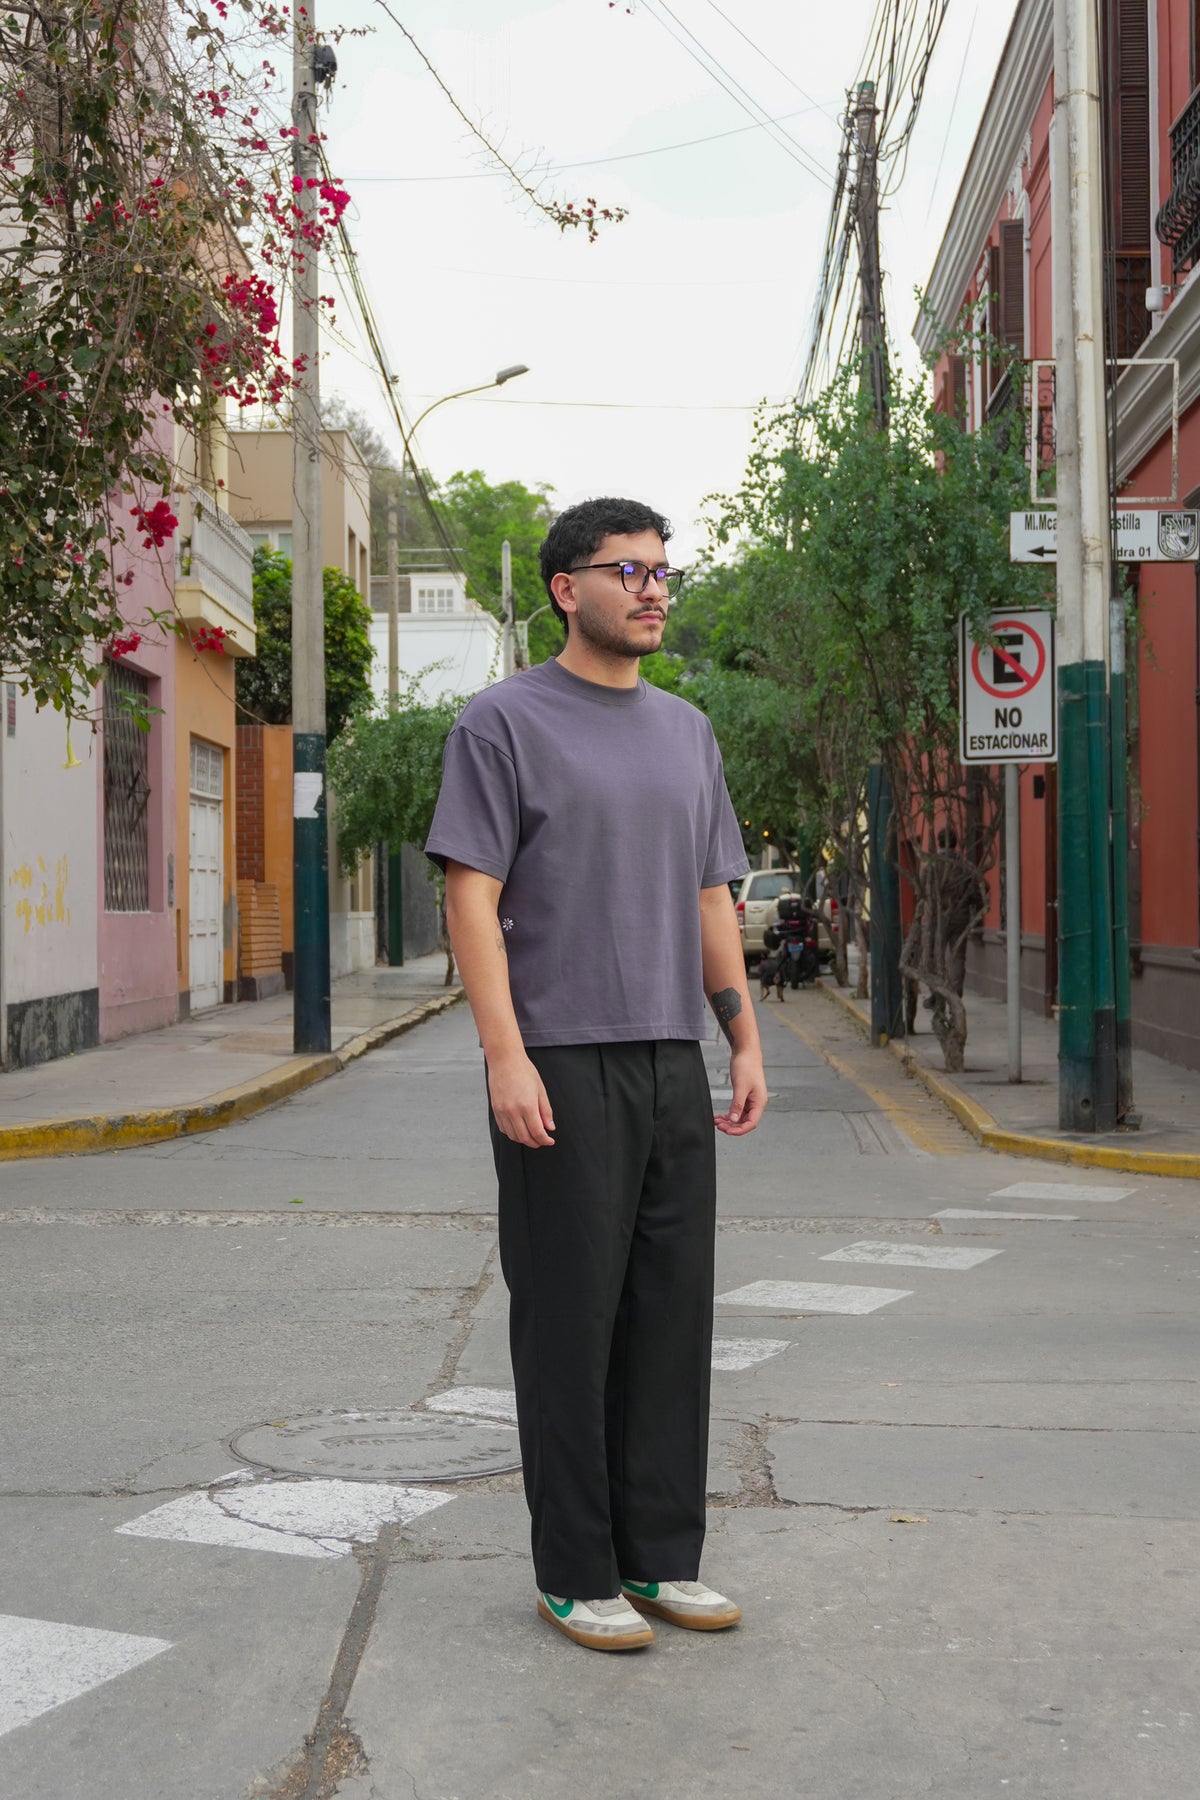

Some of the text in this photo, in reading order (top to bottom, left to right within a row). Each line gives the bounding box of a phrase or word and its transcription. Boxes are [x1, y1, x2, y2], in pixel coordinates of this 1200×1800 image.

[1115, 546, 1151, 558] dra 01
[993, 634, 1024, 684] E
[995, 707, 1023, 729] NO
[969, 733, 1048, 751] ESTACIONAR
